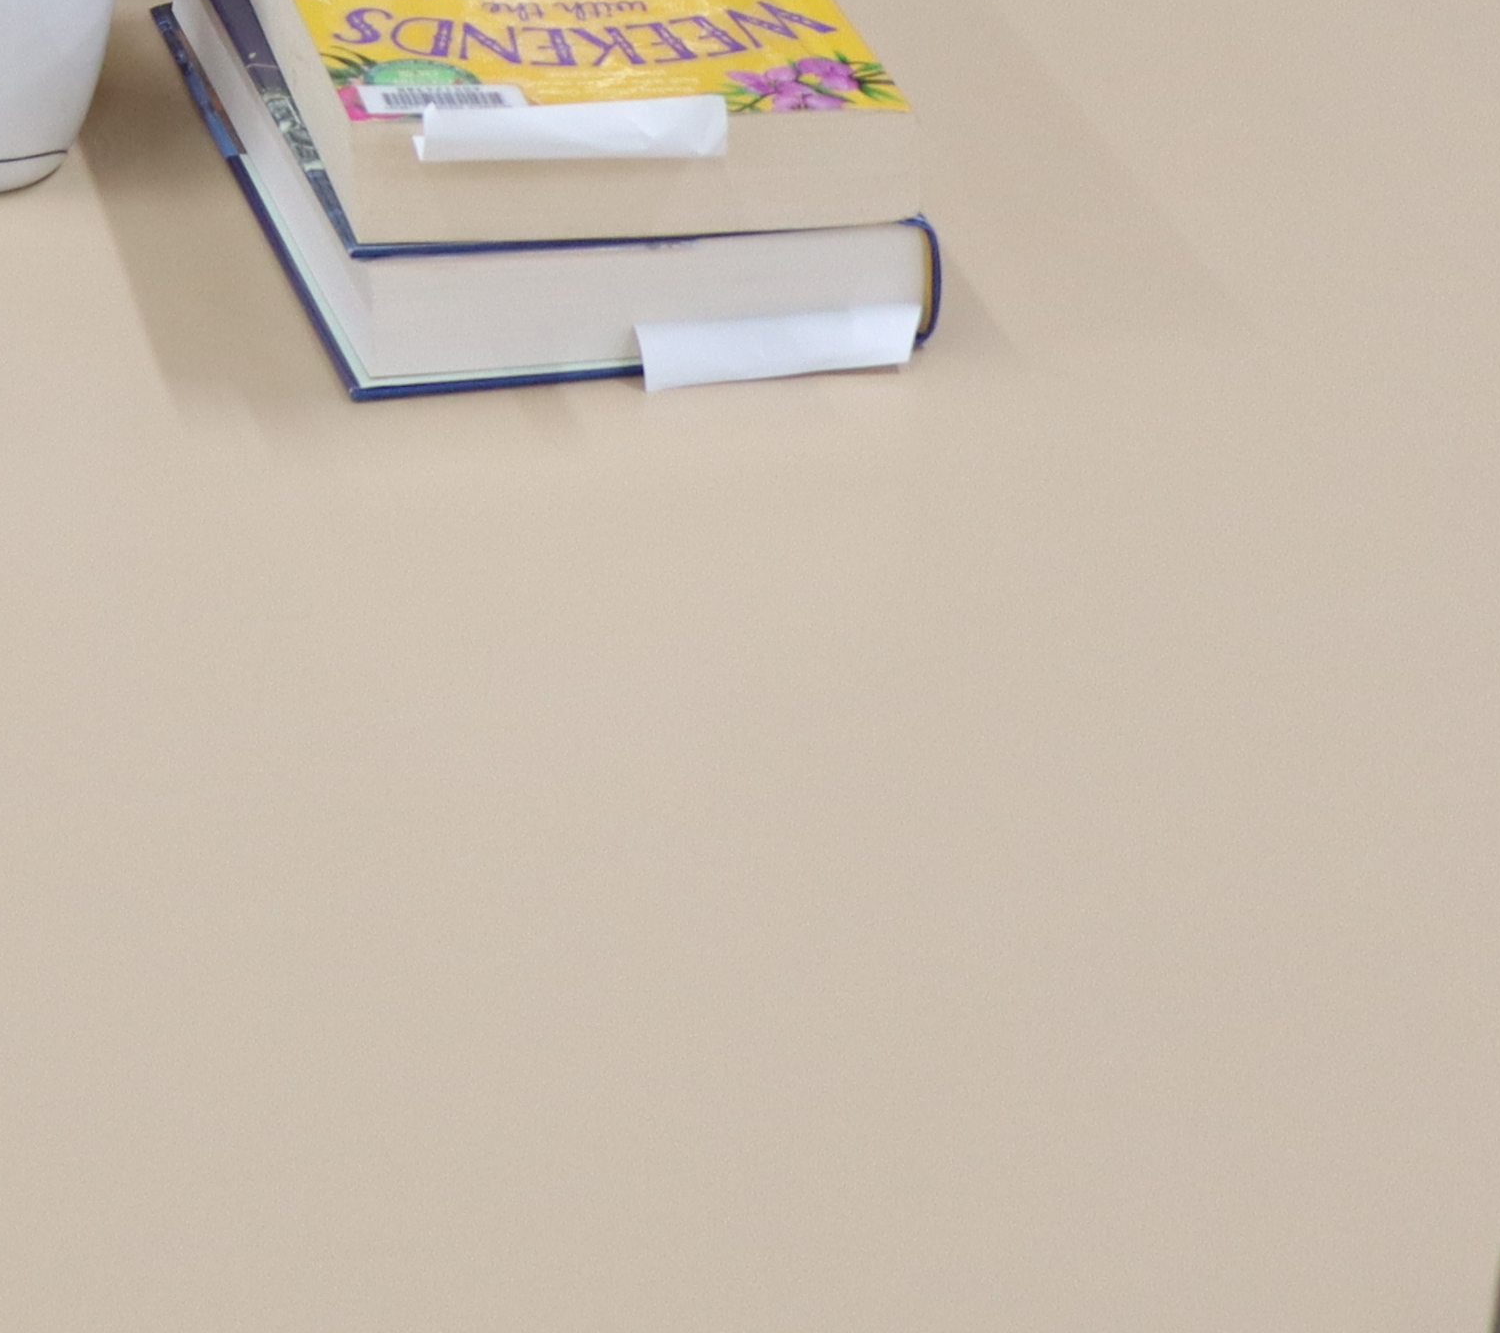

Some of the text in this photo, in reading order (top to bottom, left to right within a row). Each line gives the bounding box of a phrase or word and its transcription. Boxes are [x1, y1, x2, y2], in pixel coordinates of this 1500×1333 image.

[482, 1, 647, 20] with the
[334, 1, 837, 65] WEEKENDS
